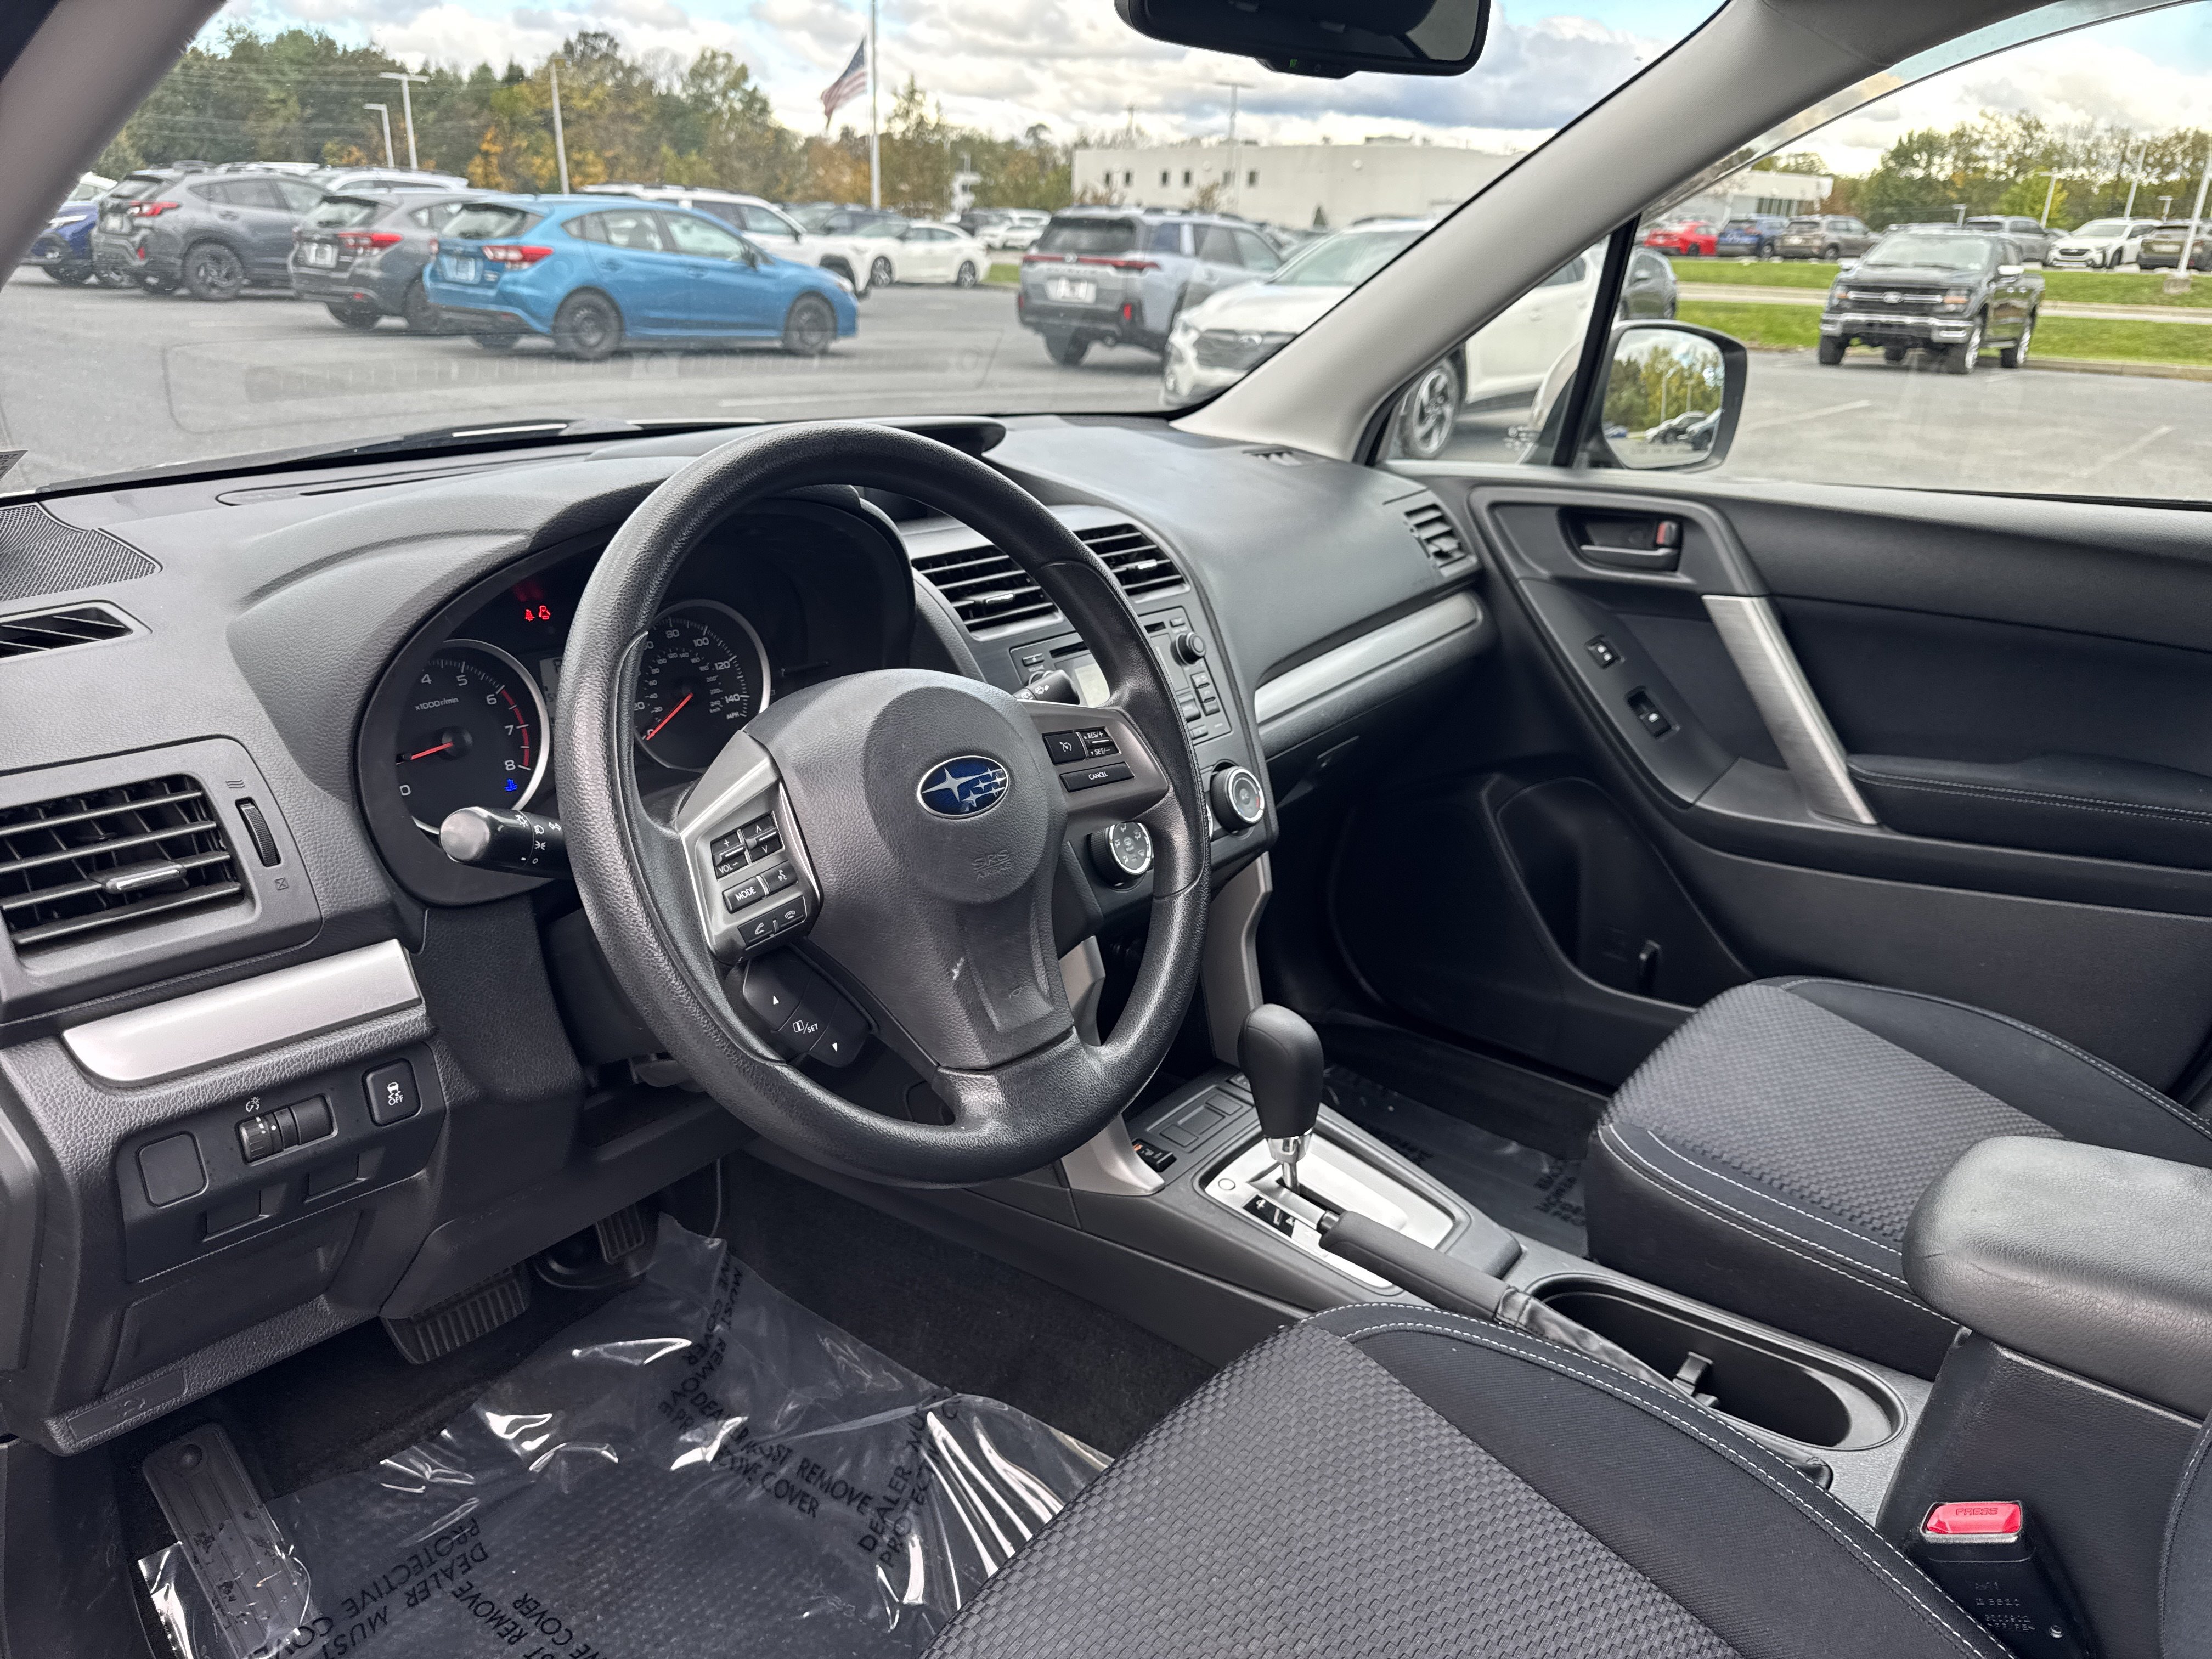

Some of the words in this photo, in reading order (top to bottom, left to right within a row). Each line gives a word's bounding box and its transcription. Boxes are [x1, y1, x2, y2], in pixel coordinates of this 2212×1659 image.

[665, 629, 680, 639] 80
[693, 637, 710, 647] 100
[714, 661, 731, 670] 120
[421, 674, 432, 684] 4
[456, 675, 468, 686] 5
[486, 694, 497, 705] 6
[725, 693, 741, 703] 140
[726, 712, 740, 720] MPH
[504, 725, 514, 736] 7
[504, 760, 516, 771] 8
[1088, 771, 1109, 780] CANCEL
[400, 784, 411, 796] 0
[735, 887, 757, 901] MODE
[388, 1095, 403, 1105] OFF
[796, 1457, 873, 1516] REMOVE
[761, 1471, 820, 1519] COVER
[858, 1465, 912, 1553] DEALER
[1955, 1507, 1998, 1516] PRESS
[340, 1517, 481, 1620] PROTECTIVE
[406, 1541, 488, 1608] DEALER
[452, 1581, 528, 1646] REMOVE
[513, 1593, 573, 1646] COVER
